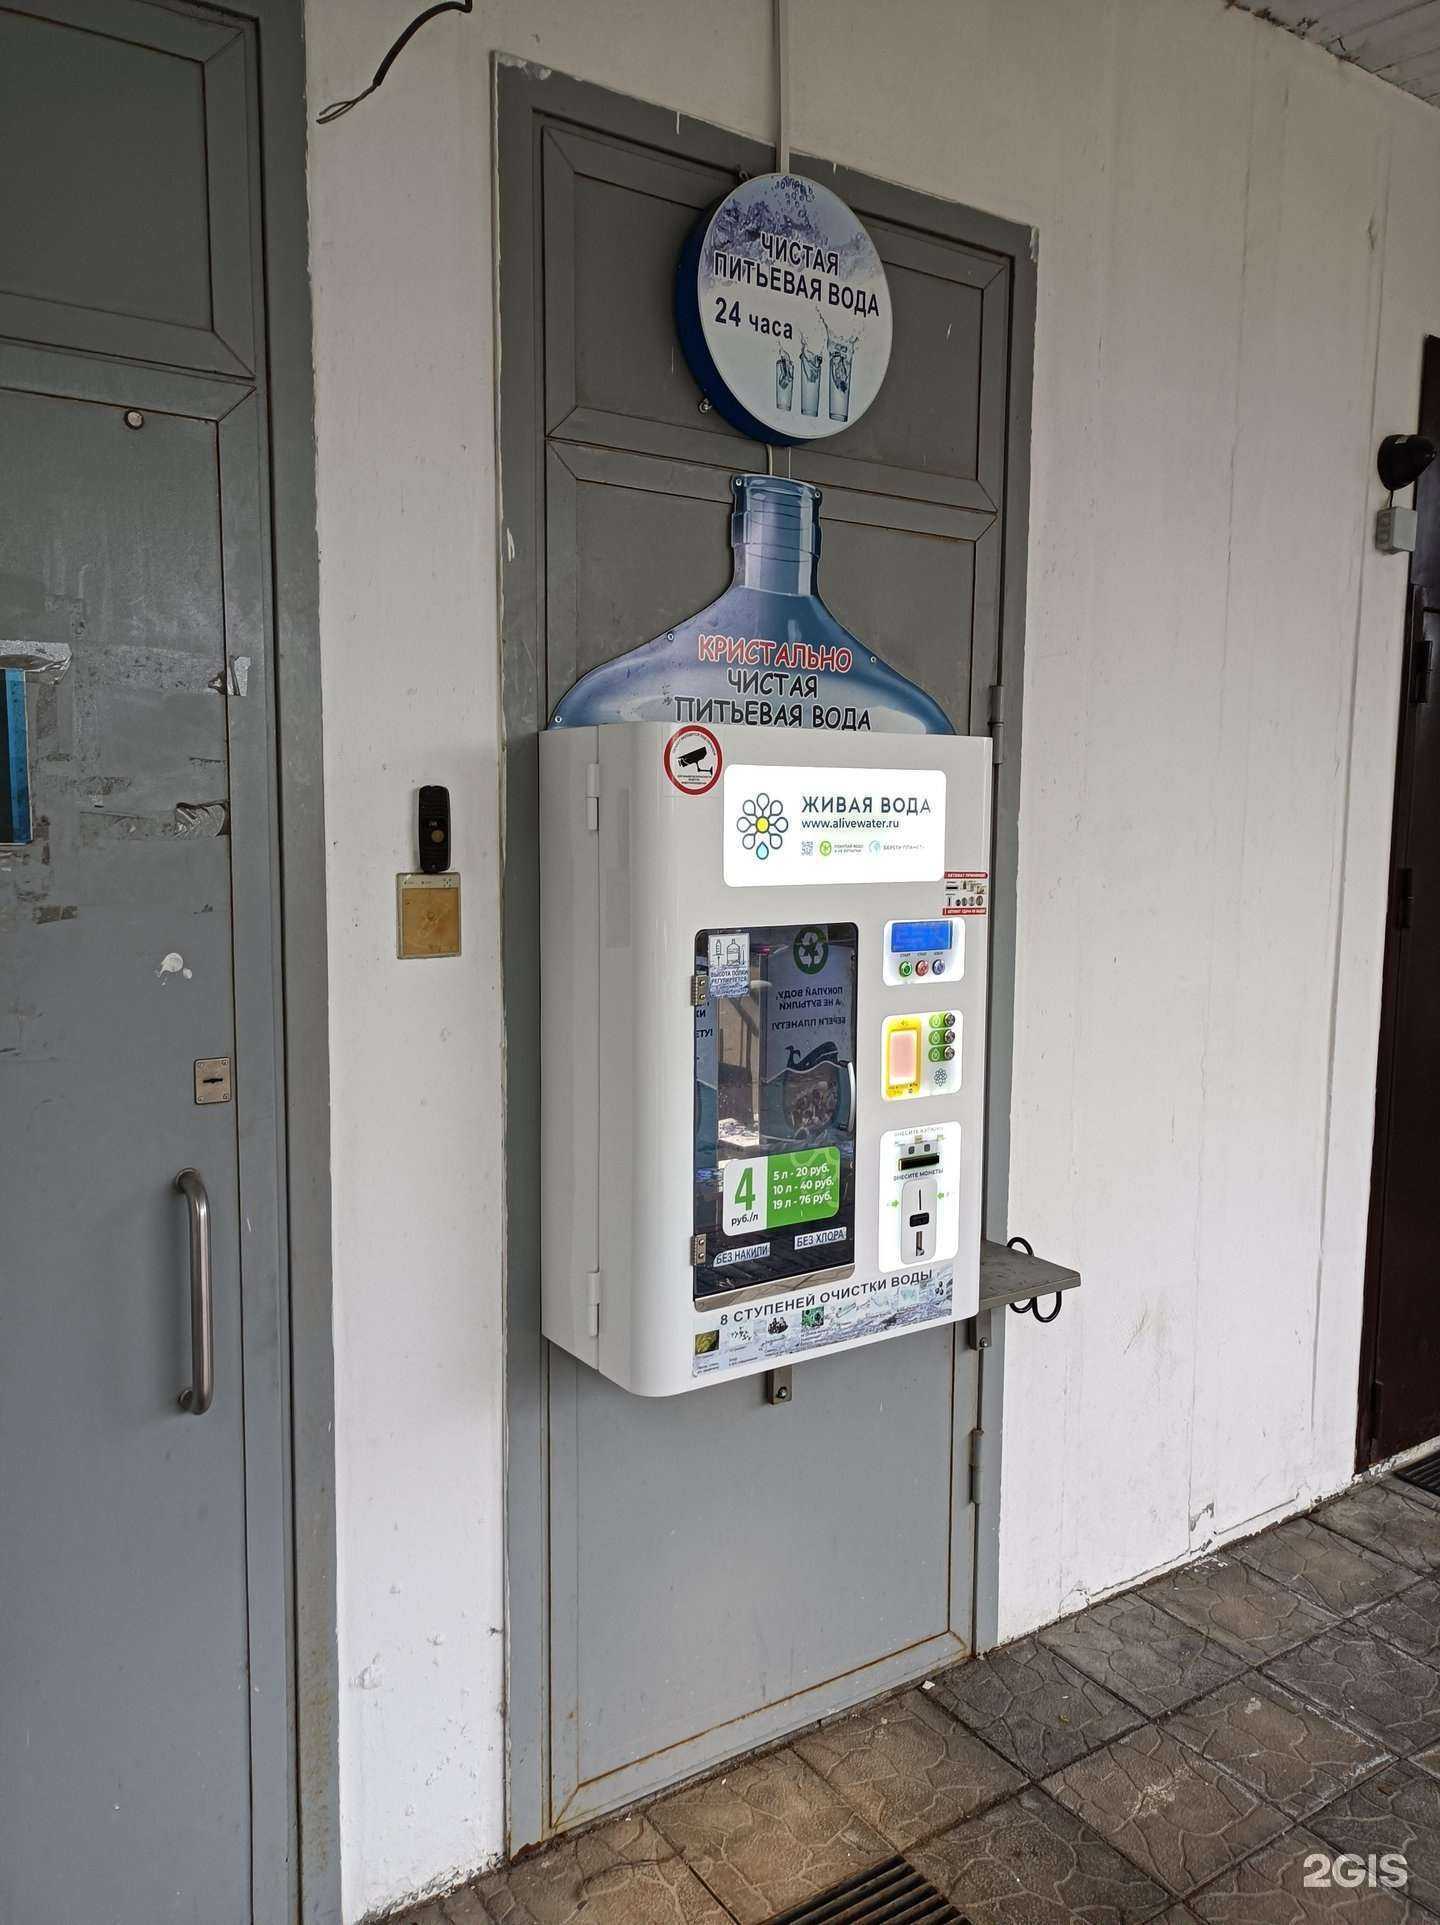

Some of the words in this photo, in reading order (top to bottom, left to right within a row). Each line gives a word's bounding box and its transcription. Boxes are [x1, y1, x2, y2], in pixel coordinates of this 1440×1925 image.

[761, 232, 839, 276] ЧИСТАЯ
[714, 251, 822, 302] ПИТЬЕВАЯ
[828, 283, 880, 318] ВОДА
[714, 297, 741, 327] 24
[748, 313, 793, 340] часа
[699, 634, 852, 673] КРИСТАЛЬНО
[727, 669, 818, 699] ЧИСТАЯ
[673, 696, 803, 728] ПИТЬЕВАЯ
[811, 704, 871, 732] ВОДА
[801, 796, 872, 813] ЖИВАЯ
[880, 797, 931, 816] ВОДА
[801, 817, 900, 829] www.alivewater.ru
[773, 1170, 780, 1181] 5
[780, 1170, 788, 1180] л
[796, 1166, 808, 1177] 20
[810, 1163, 830, 1177] руб.
[893, 1172, 919, 1181] ВНЕСИТЕ
[919, 1168, 944, 1177] МОНЕТЫ
[734, 1167, 756, 1211] 4
[773, 1184, 784, 1195] 10
[785, 1184, 792, 1192] л
[800, 1179, 813, 1190] 40
[815, 1176, 834, 1189] руб.
[773, 1199, 783, 1210] 19
[784, 1199, 792, 1208] л
[800, 1194, 811, 1205] 76
[813, 1191, 833, 1205] руб.
[731, 1212, 759, 1227] руб./л
[796, 1234, 815, 1248] БЕЗ
[815, 1229, 846, 1244] ХЛОРА
[716, 1251, 733, 1265] БЕЗ
[734, 1245, 769, 1260] НАКИПИ
[720, 1314, 728, 1326] 8
[733, 1293, 816, 1323] СТУПЕНЕЙ
[819, 1279, 888, 1304] ОЧИСТКИ
[891, 1269, 933, 1288] ВОДЫ
